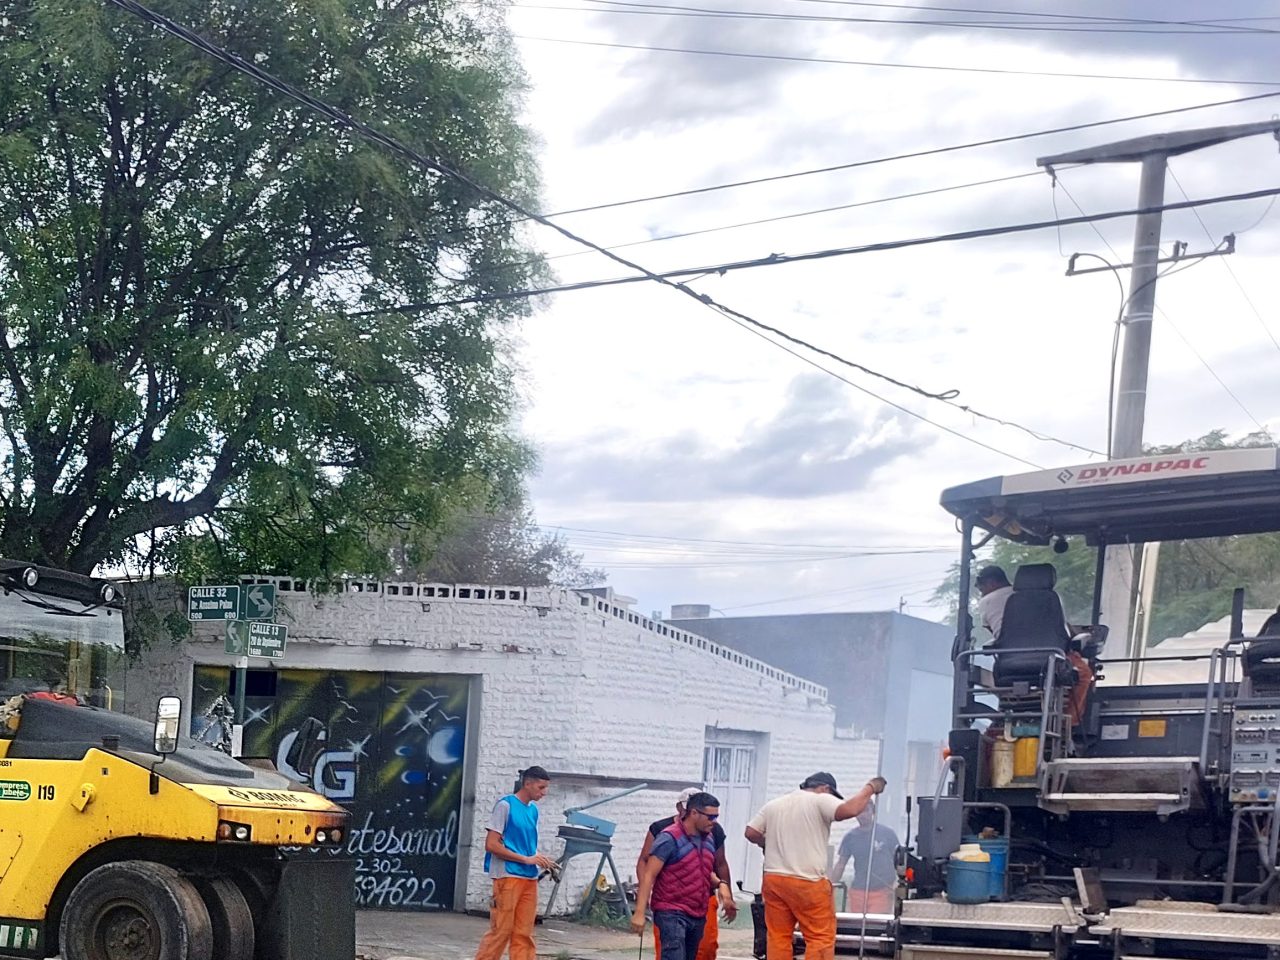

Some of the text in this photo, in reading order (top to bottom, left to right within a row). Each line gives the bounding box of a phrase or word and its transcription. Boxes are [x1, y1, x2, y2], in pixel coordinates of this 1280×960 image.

[1076, 456, 1210, 480] DYNAPAC
[191, 587, 227, 598] CALLE 32
[224, 611, 236, 619] 600
[251, 624, 279, 636] CALLE 13
[330, 810, 459, 859] rtesanal
